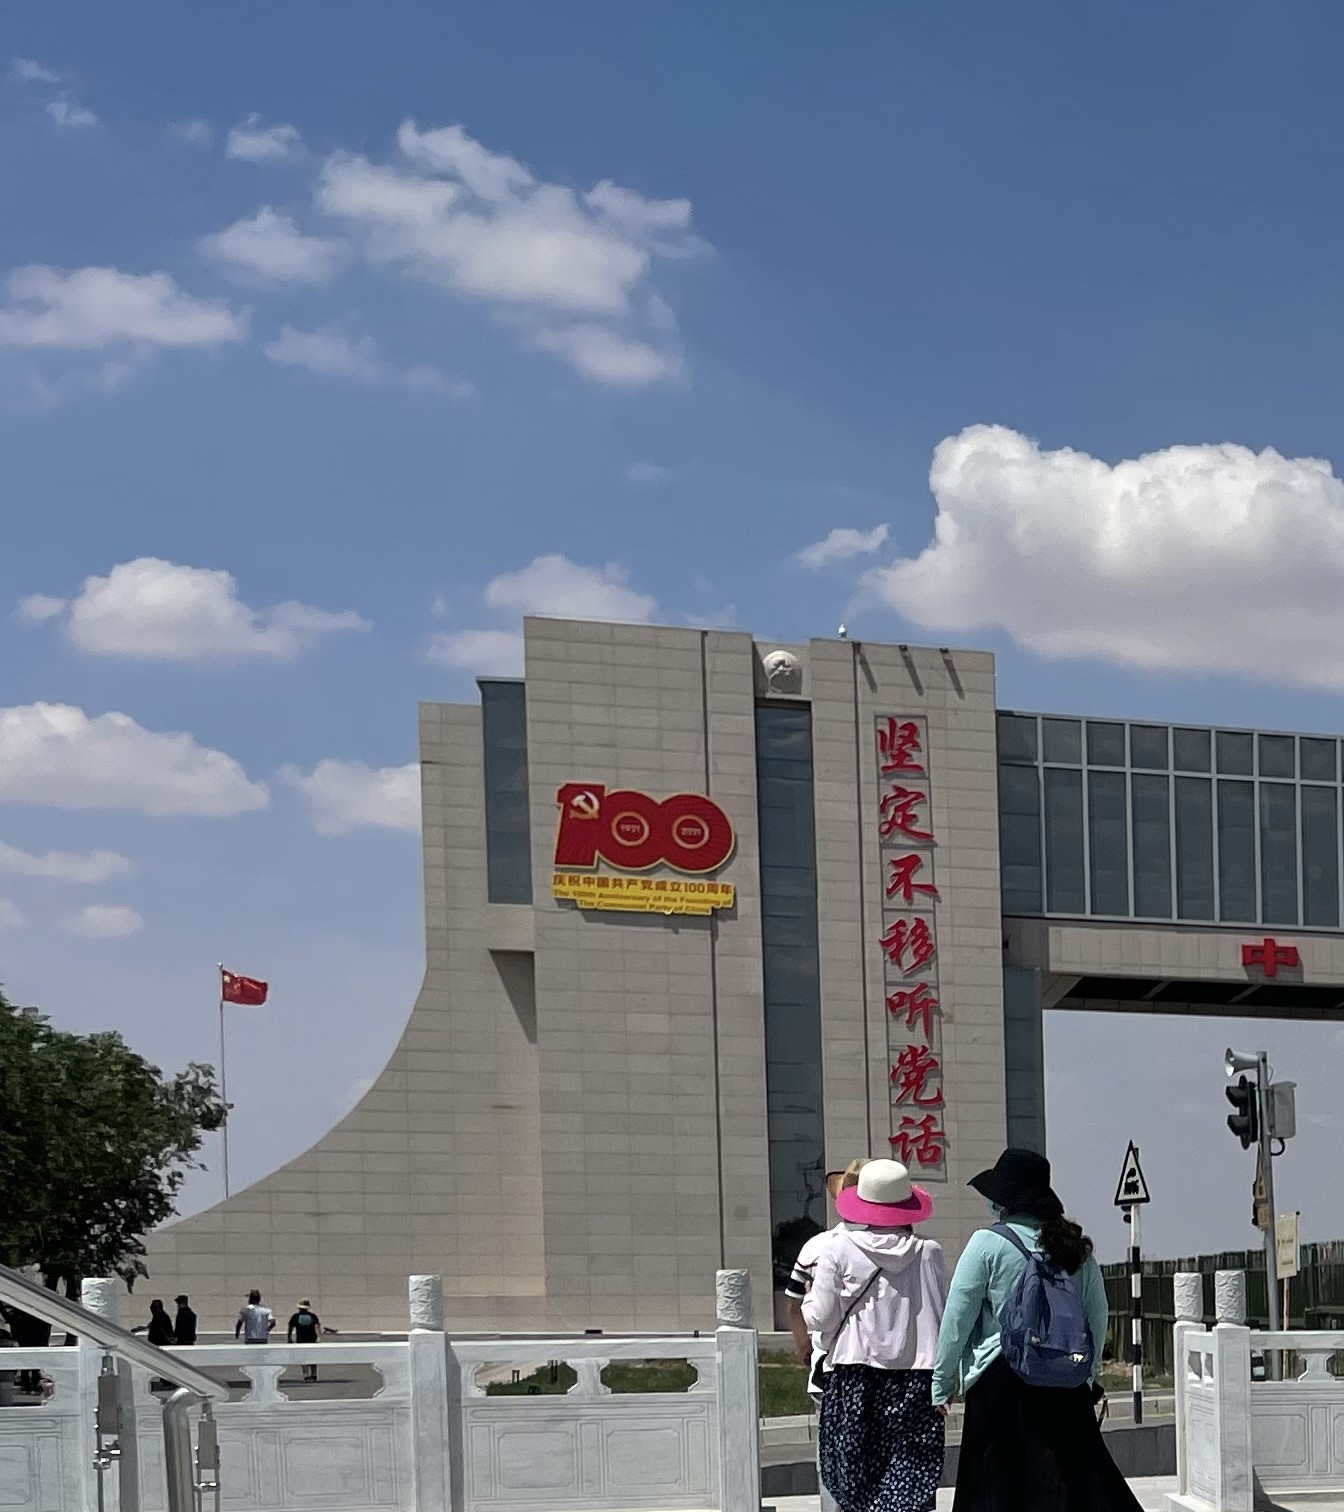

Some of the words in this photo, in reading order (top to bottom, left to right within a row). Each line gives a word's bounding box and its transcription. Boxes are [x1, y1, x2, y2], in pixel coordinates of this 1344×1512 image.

[554, 781, 734, 873] 100
[553, 874, 733, 895] 庆祝中国共产党成立100周年
[876, 716, 947, 1168] 坚定不移听党话
